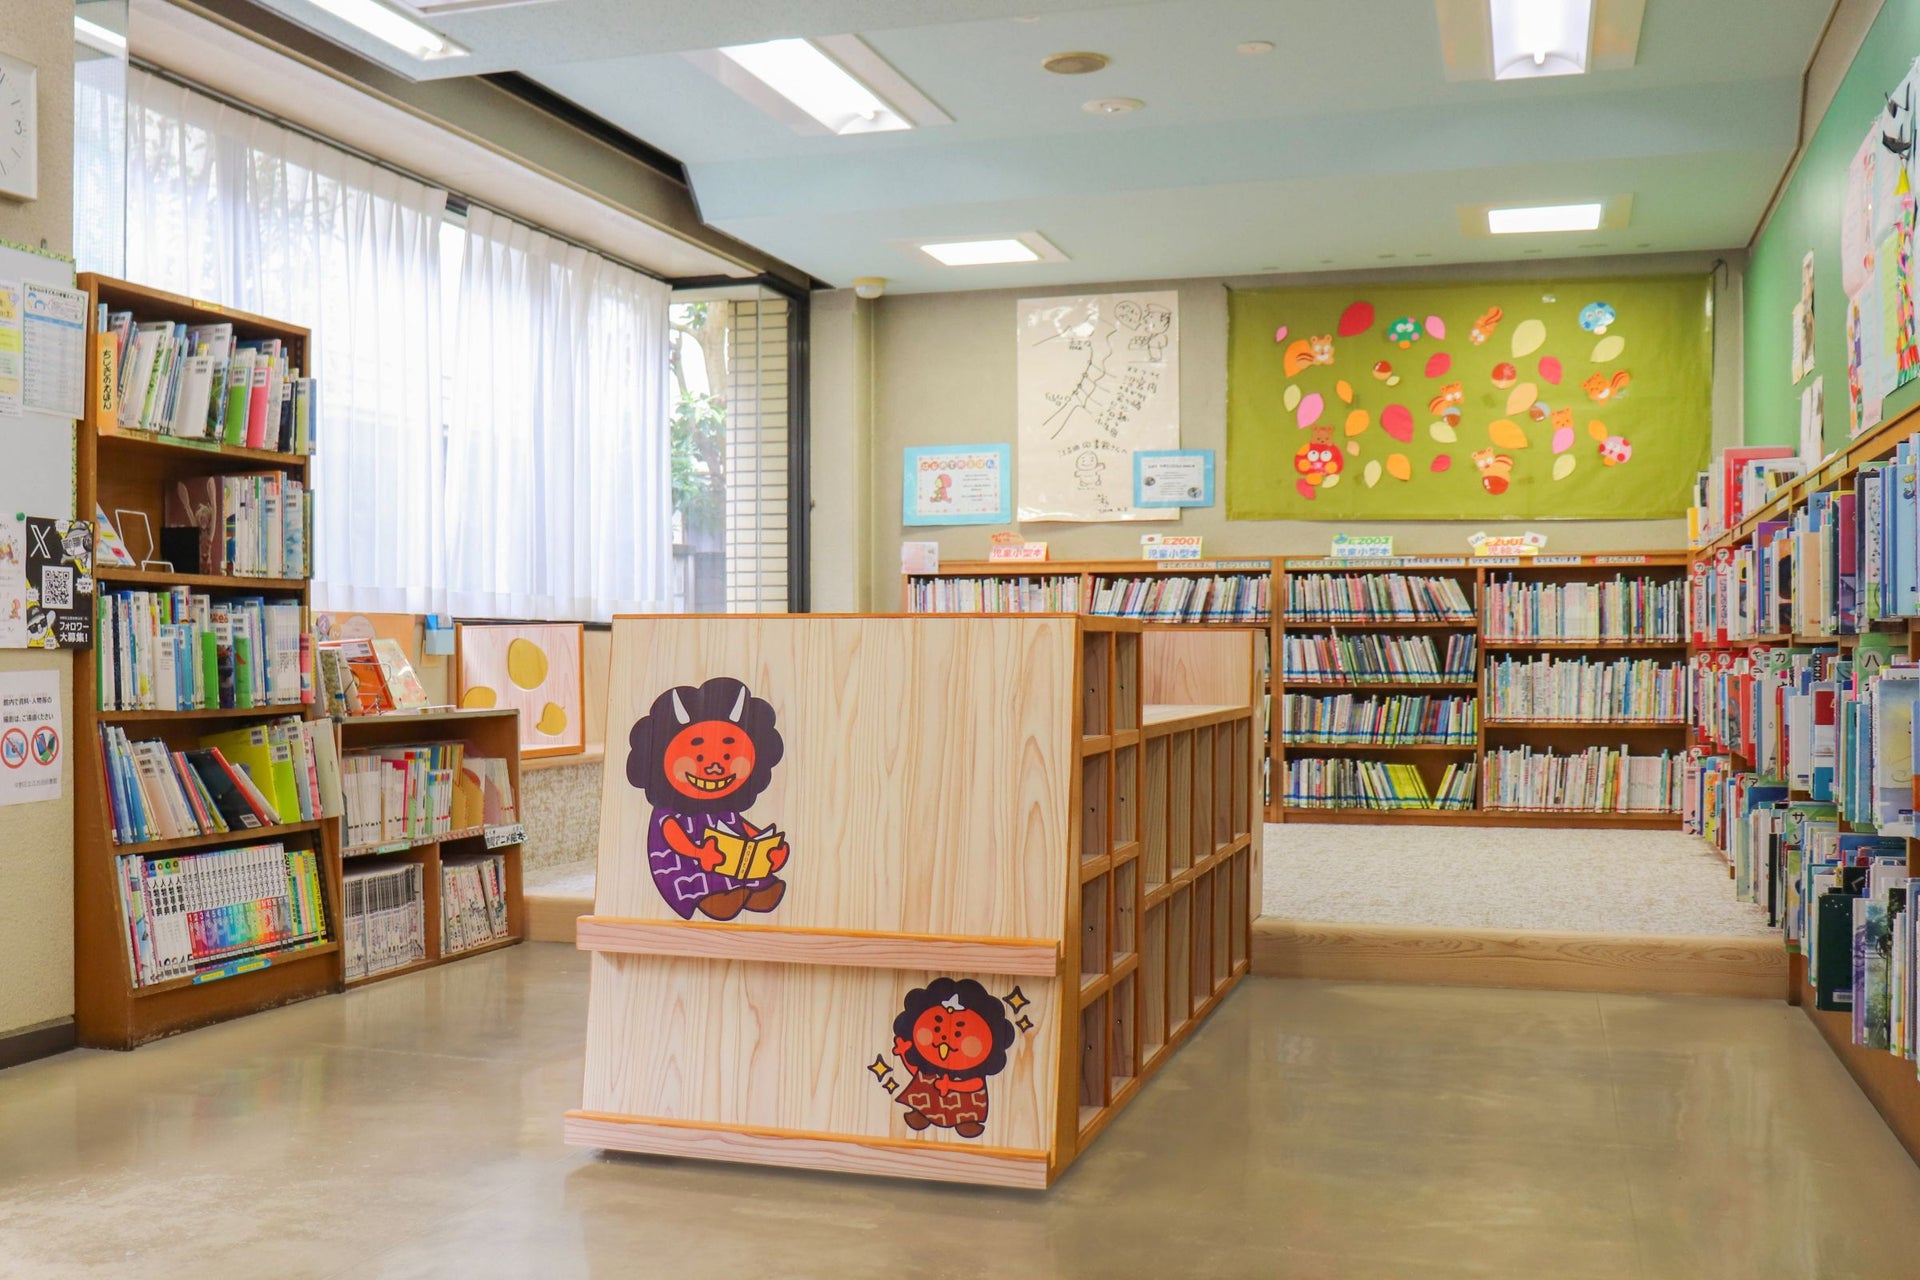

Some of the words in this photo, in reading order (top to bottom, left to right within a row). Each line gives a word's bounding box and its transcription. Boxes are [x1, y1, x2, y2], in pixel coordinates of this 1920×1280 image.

[102, 349, 112, 411] ちしきのえほん
[30, 524, 52, 559] X
[993, 547, 1043, 558] 児童小型本
[1148, 548, 1200, 559] 児童小型本
[1337, 547, 1391, 556] 児童小型本
[59, 621, 90, 632] フォロワー
[59, 632, 89, 643] 大募集!
[1775, 652, 1786, 662] カ
[1864, 654, 1880, 668] ハ
[3, 696, 53, 707] 館内で資料・人物等の
[3, 713, 55, 723] 撮影は、ご遠慮ください
[1792, 811, 1805, 825] サ
